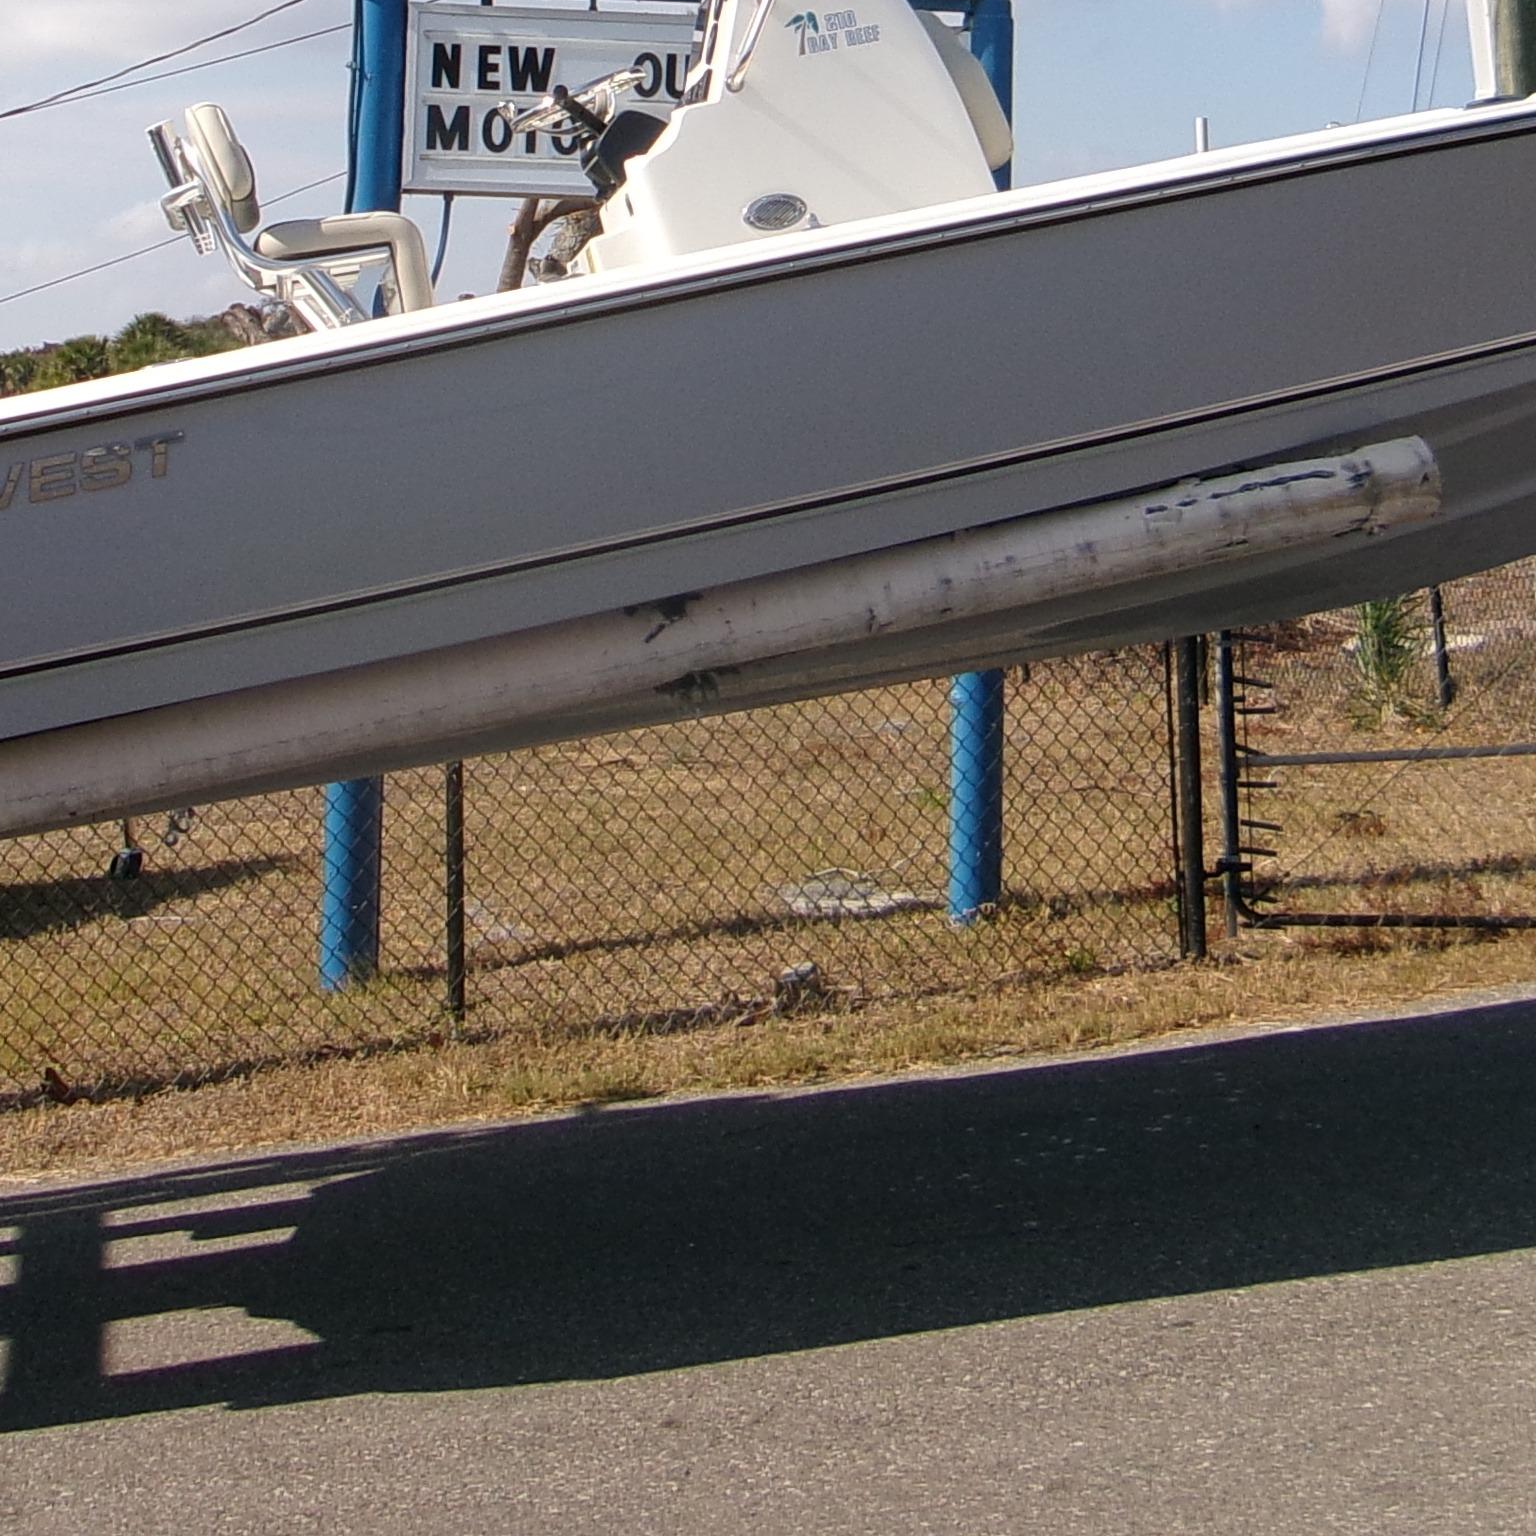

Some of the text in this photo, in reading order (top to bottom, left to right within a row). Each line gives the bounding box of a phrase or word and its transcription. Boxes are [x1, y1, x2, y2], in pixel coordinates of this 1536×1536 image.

[431, 42, 556, 93] NEW
[807, 32, 837, 54] BAY
[425, 103, 580, 156] MOTO
